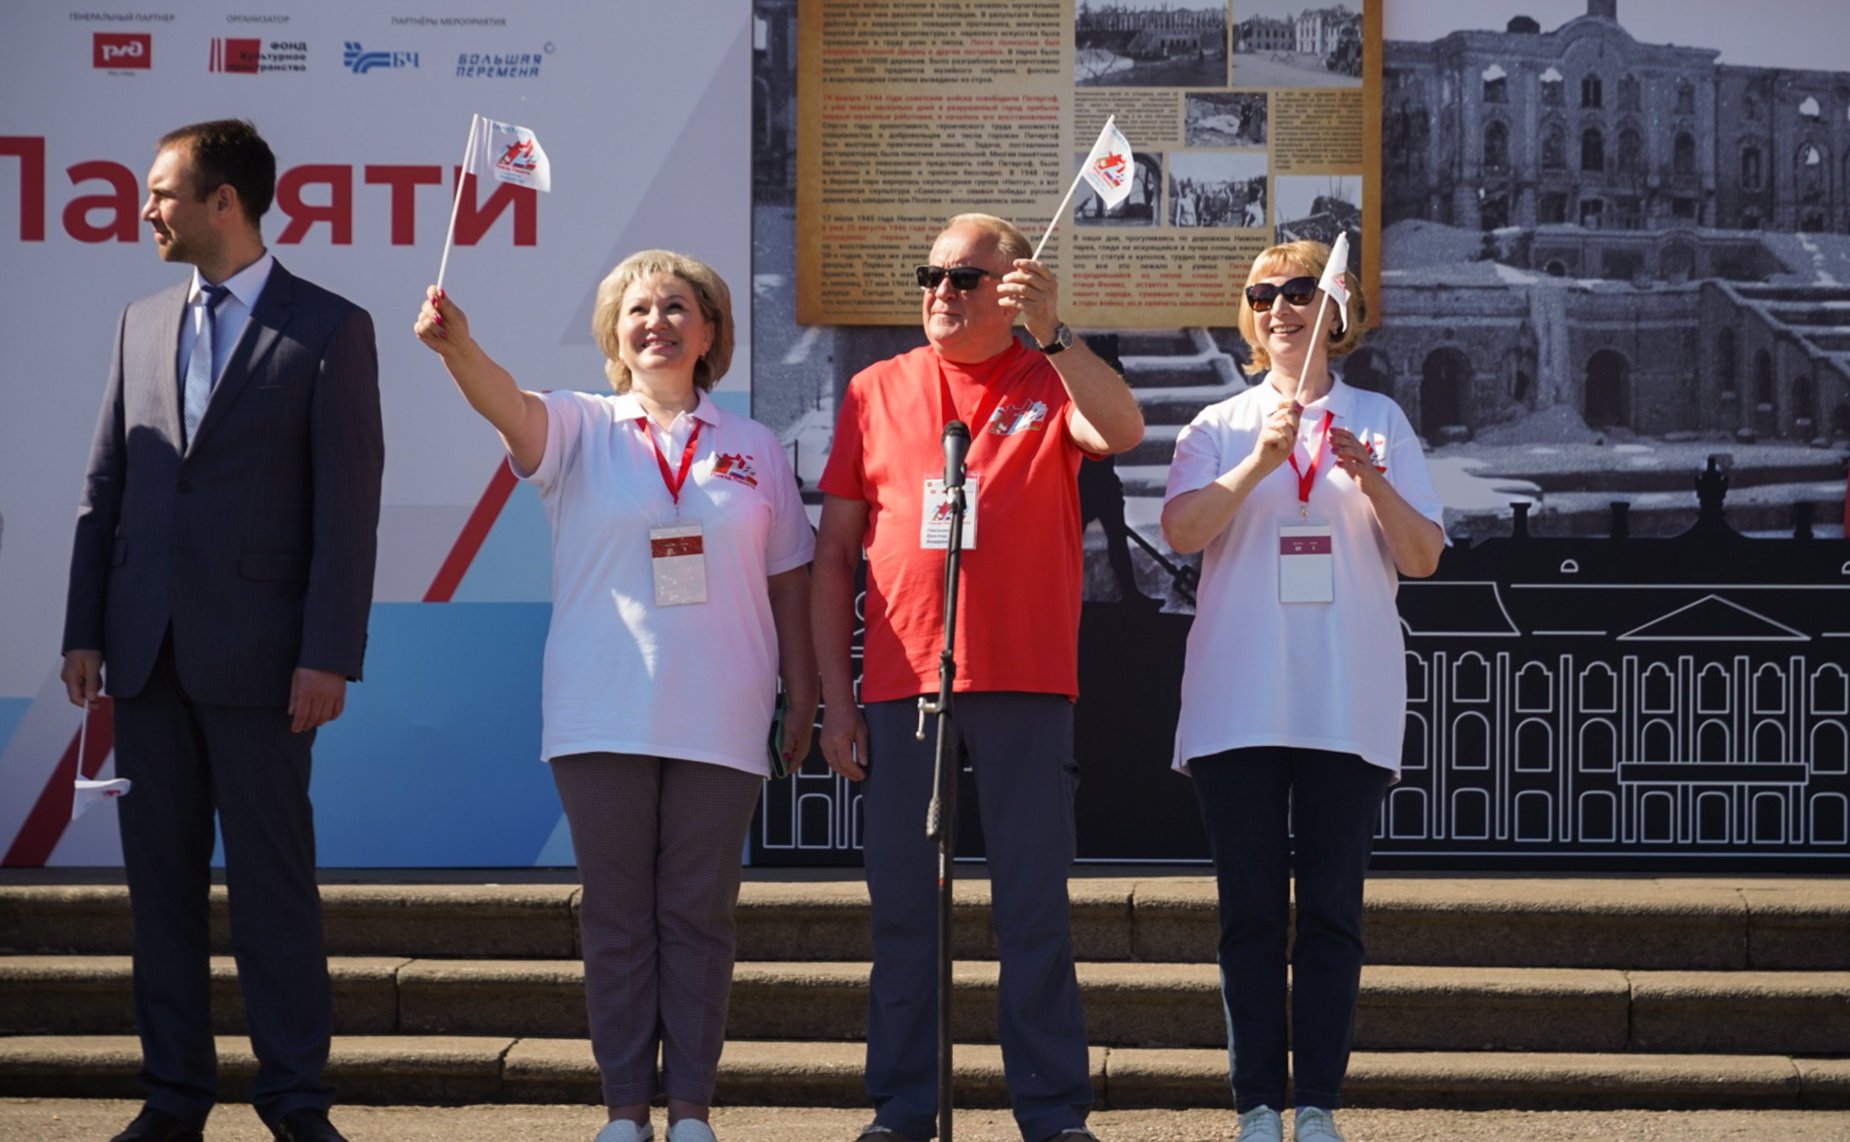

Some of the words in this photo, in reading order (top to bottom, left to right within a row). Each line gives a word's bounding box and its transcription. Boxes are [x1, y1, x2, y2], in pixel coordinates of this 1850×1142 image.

[69, 12, 134, 21] ГЕНЕРАЛЬНЫЙ
[226, 14, 290, 23] ОРГАНИЗАТОР
[440, 17, 507, 26] МЕРОПРИЯТИЯ
[270, 42, 308, 51] ФОНД
[458, 54, 542, 65] БОЛЬШАЯ
[456, 67, 540, 77] ПЕРЕМЕНА
[0, 136, 537, 246] Паяти
